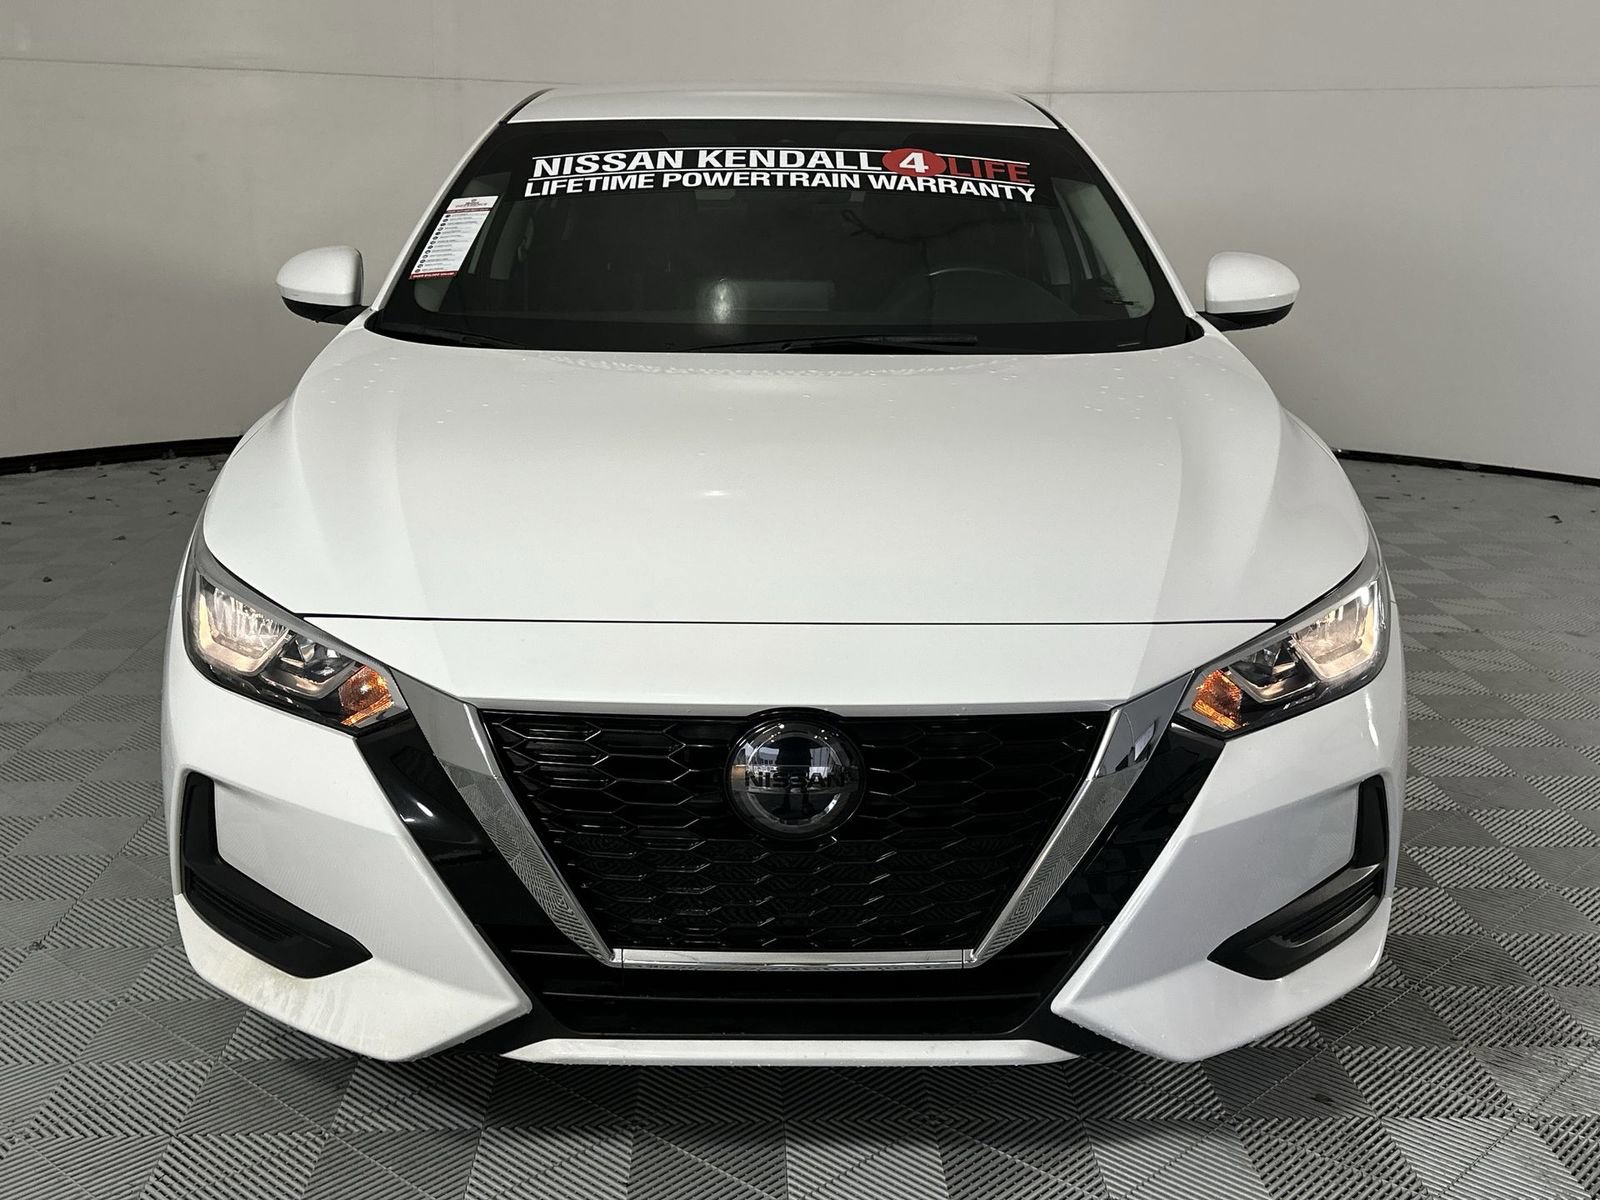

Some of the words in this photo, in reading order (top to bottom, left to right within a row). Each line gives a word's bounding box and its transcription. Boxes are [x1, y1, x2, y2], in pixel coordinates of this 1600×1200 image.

[533, 150, 684, 178] NISSAN
[697, 149, 882, 171] KENDALL
[899, 151, 929, 173] 4
[948, 157, 1031, 183] LIFE
[524, 173, 654, 198] LIFETIME
[662, 171, 861, 189] POWERTRAIN
[868, 174, 1036, 203] WARRANTY
[744, 771, 846, 788] NISSAN
